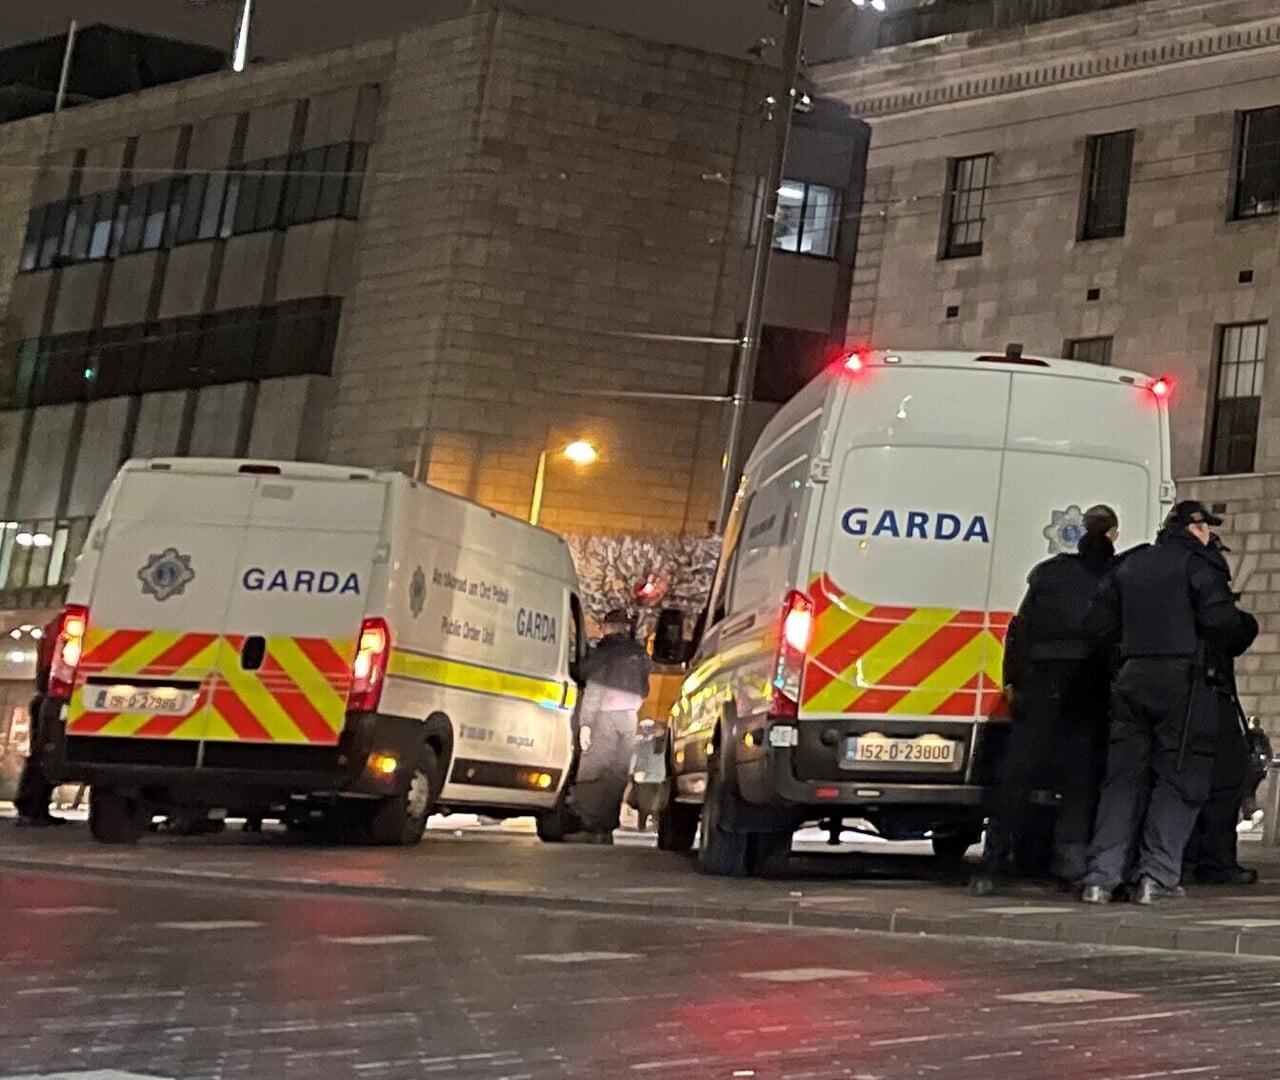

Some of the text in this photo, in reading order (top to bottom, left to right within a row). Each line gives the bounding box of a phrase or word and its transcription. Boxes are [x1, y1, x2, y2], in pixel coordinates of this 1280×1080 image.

[841, 507, 990, 544] GARDA
[242, 567, 360, 595] GARDA
[517, 608, 556, 644] GARDA
